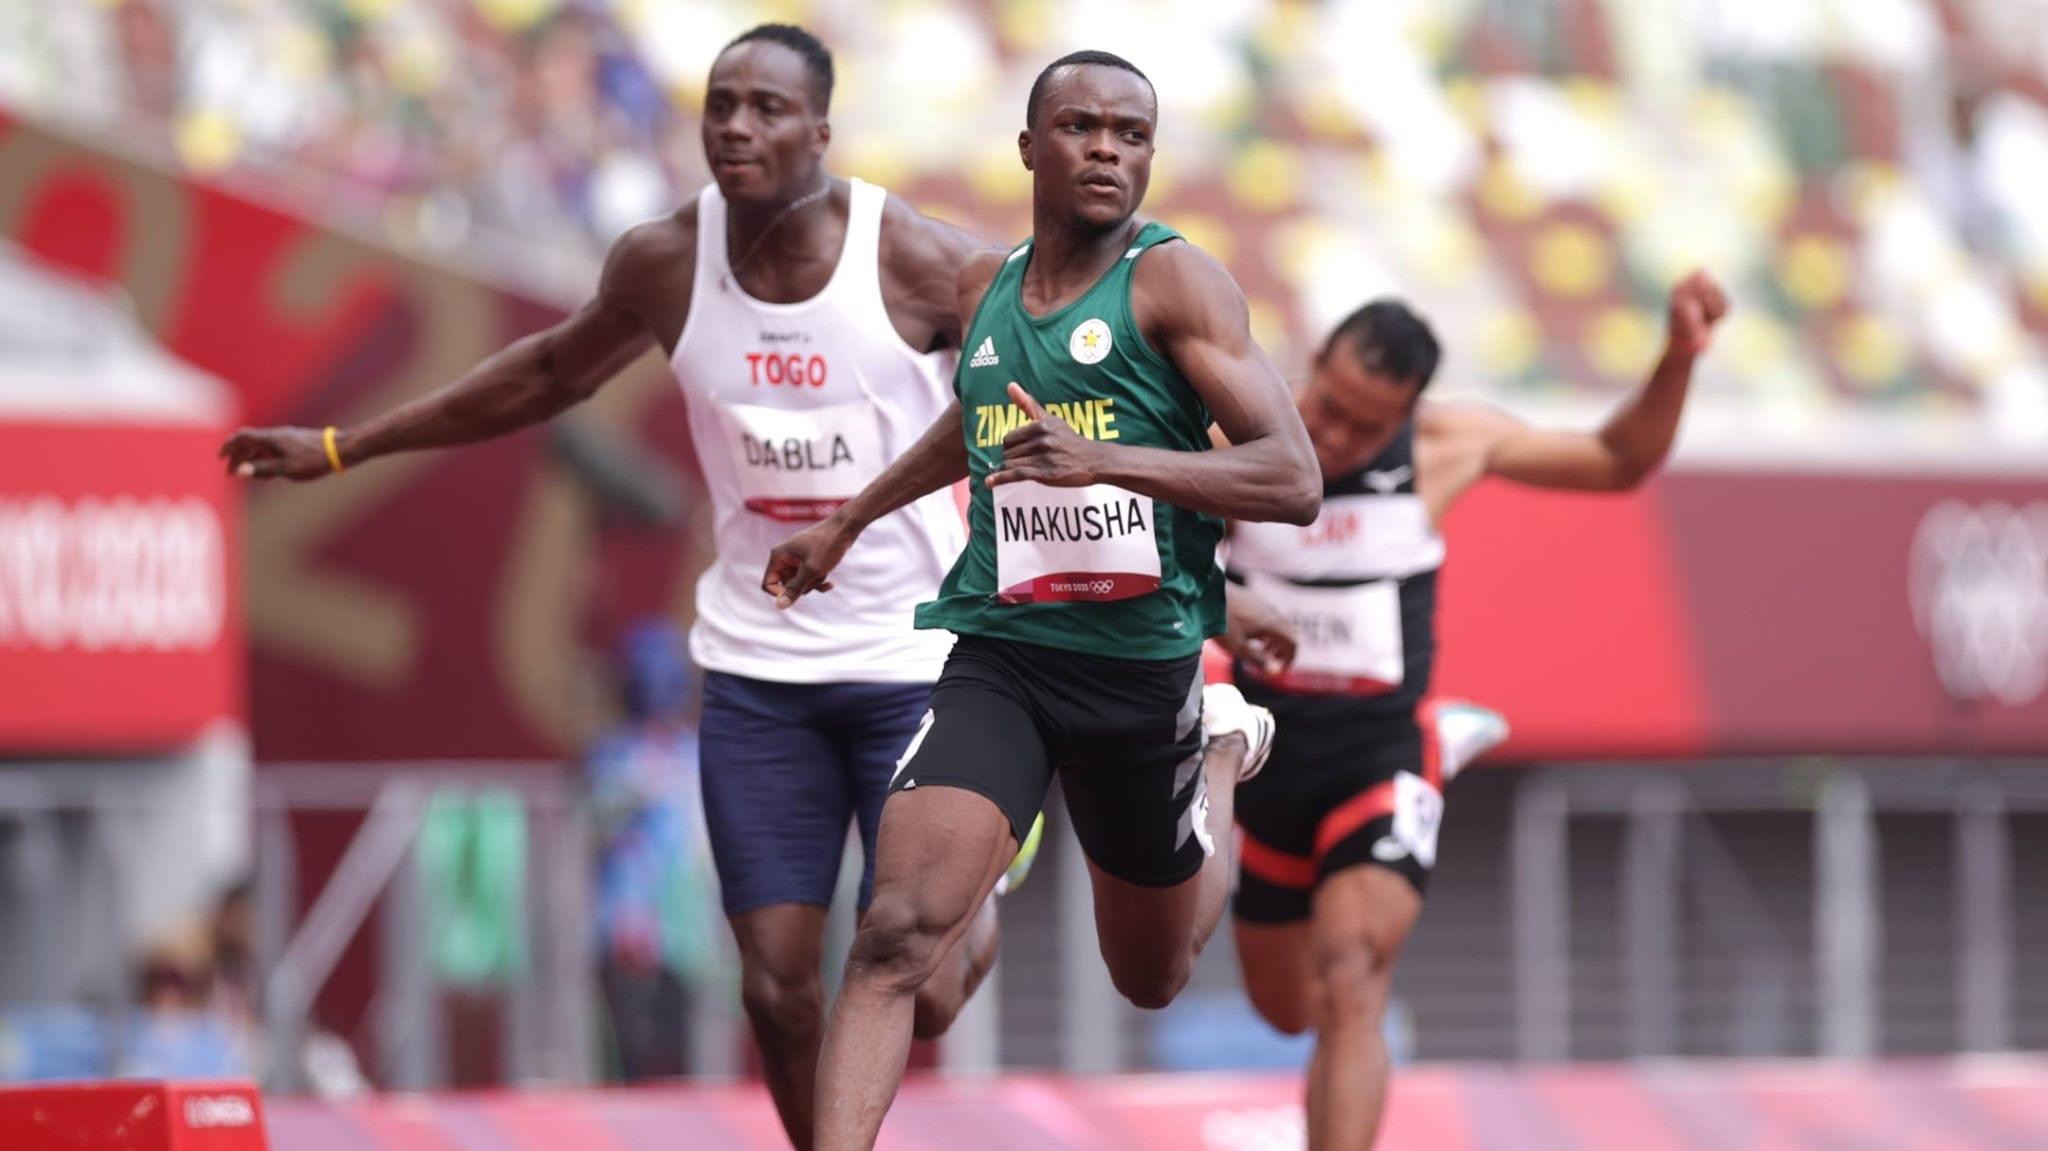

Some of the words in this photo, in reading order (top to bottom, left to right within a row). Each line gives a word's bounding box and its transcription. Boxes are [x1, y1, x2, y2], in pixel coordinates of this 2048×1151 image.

[745, 352, 827, 387] TOGO
[970, 355, 999, 368] adidas
[976, 398, 1120, 448] ZIMWE
[742, 432, 854, 470] DABLA
[1001, 497, 1146, 542] MAKUSHA
[1050, 583, 1072, 593] TOKYO
[1072, 583, 1089, 592] 2020
